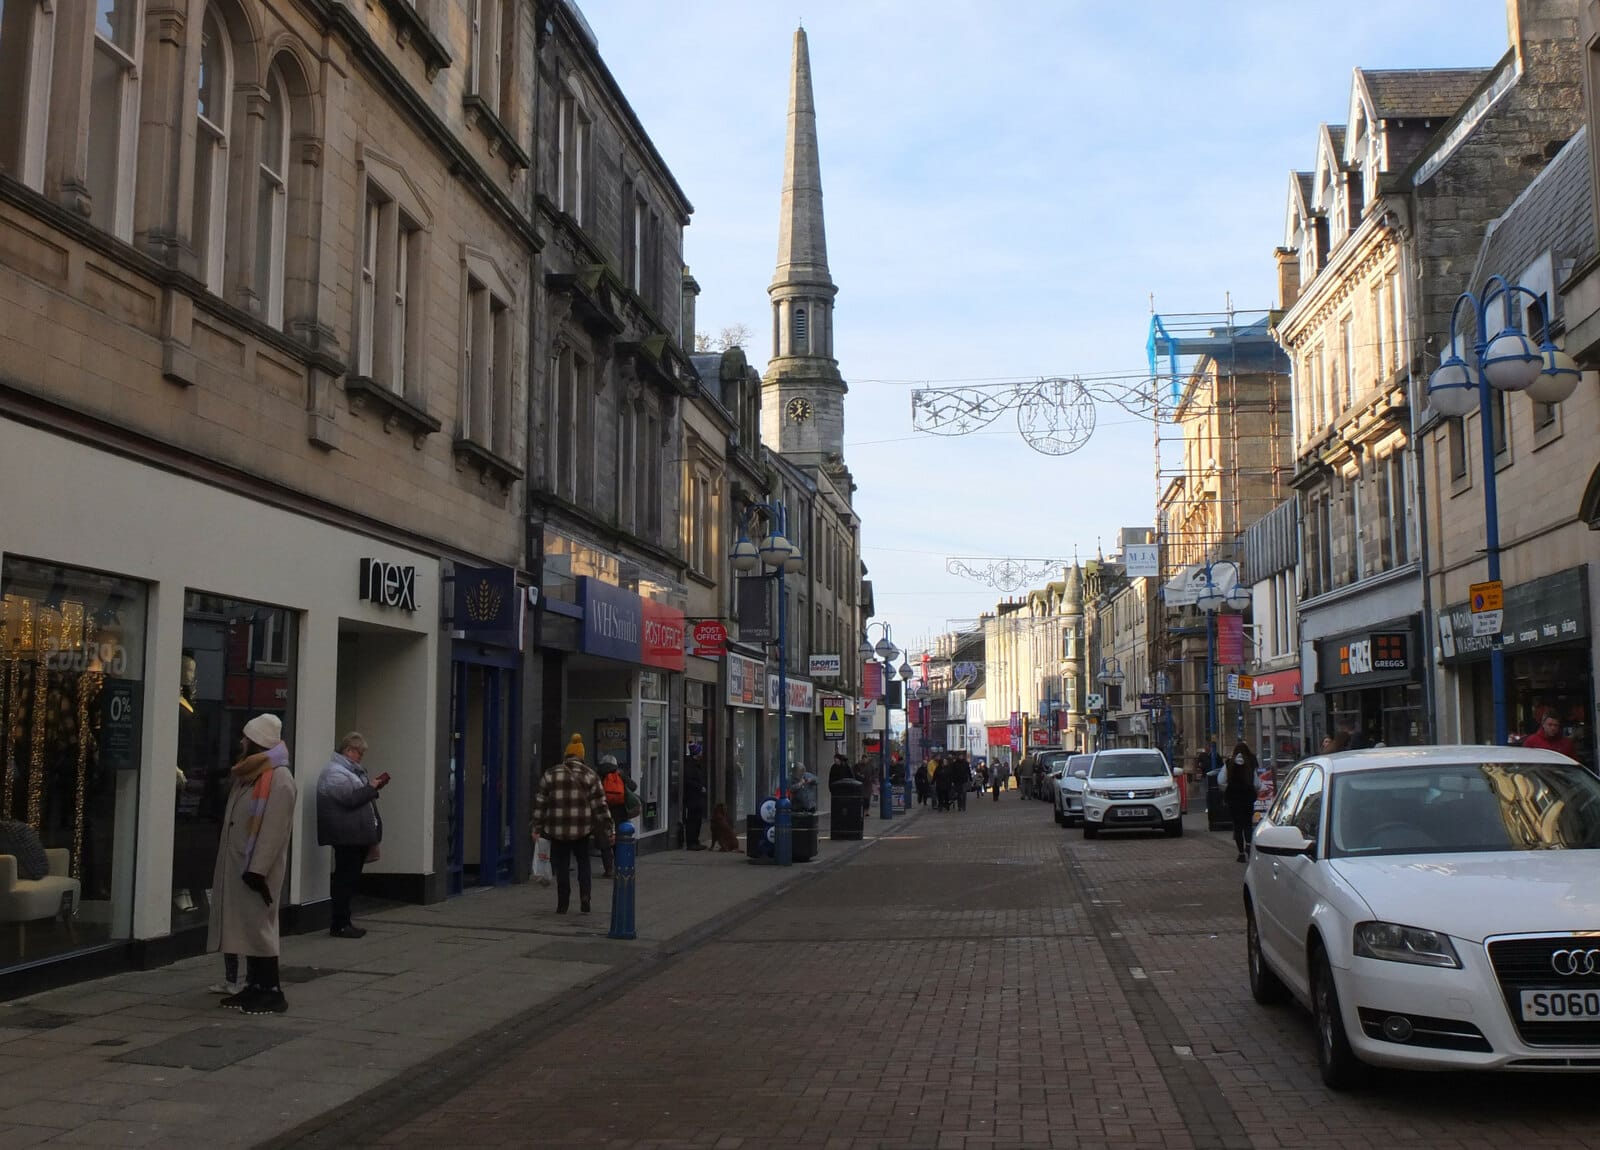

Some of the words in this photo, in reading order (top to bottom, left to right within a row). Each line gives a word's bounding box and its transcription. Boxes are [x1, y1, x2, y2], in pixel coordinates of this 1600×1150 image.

[364, 556, 421, 611] next
[593, 599, 638, 644] WHSmith
[701, 626, 720, 634] POST
[1452, 611, 1473, 630] MOUN
[645, 620, 661, 645] POST
[662, 622, 681, 650] OFFICE
[696, 633, 723, 641] OFFICE
[1456, 634, 1493, 654] WAREHOU
[1349, 639, 1374, 675] GRE
[1374, 660, 1405, 668] GREGGS
[1533, 993, 1600, 1016] SO60
